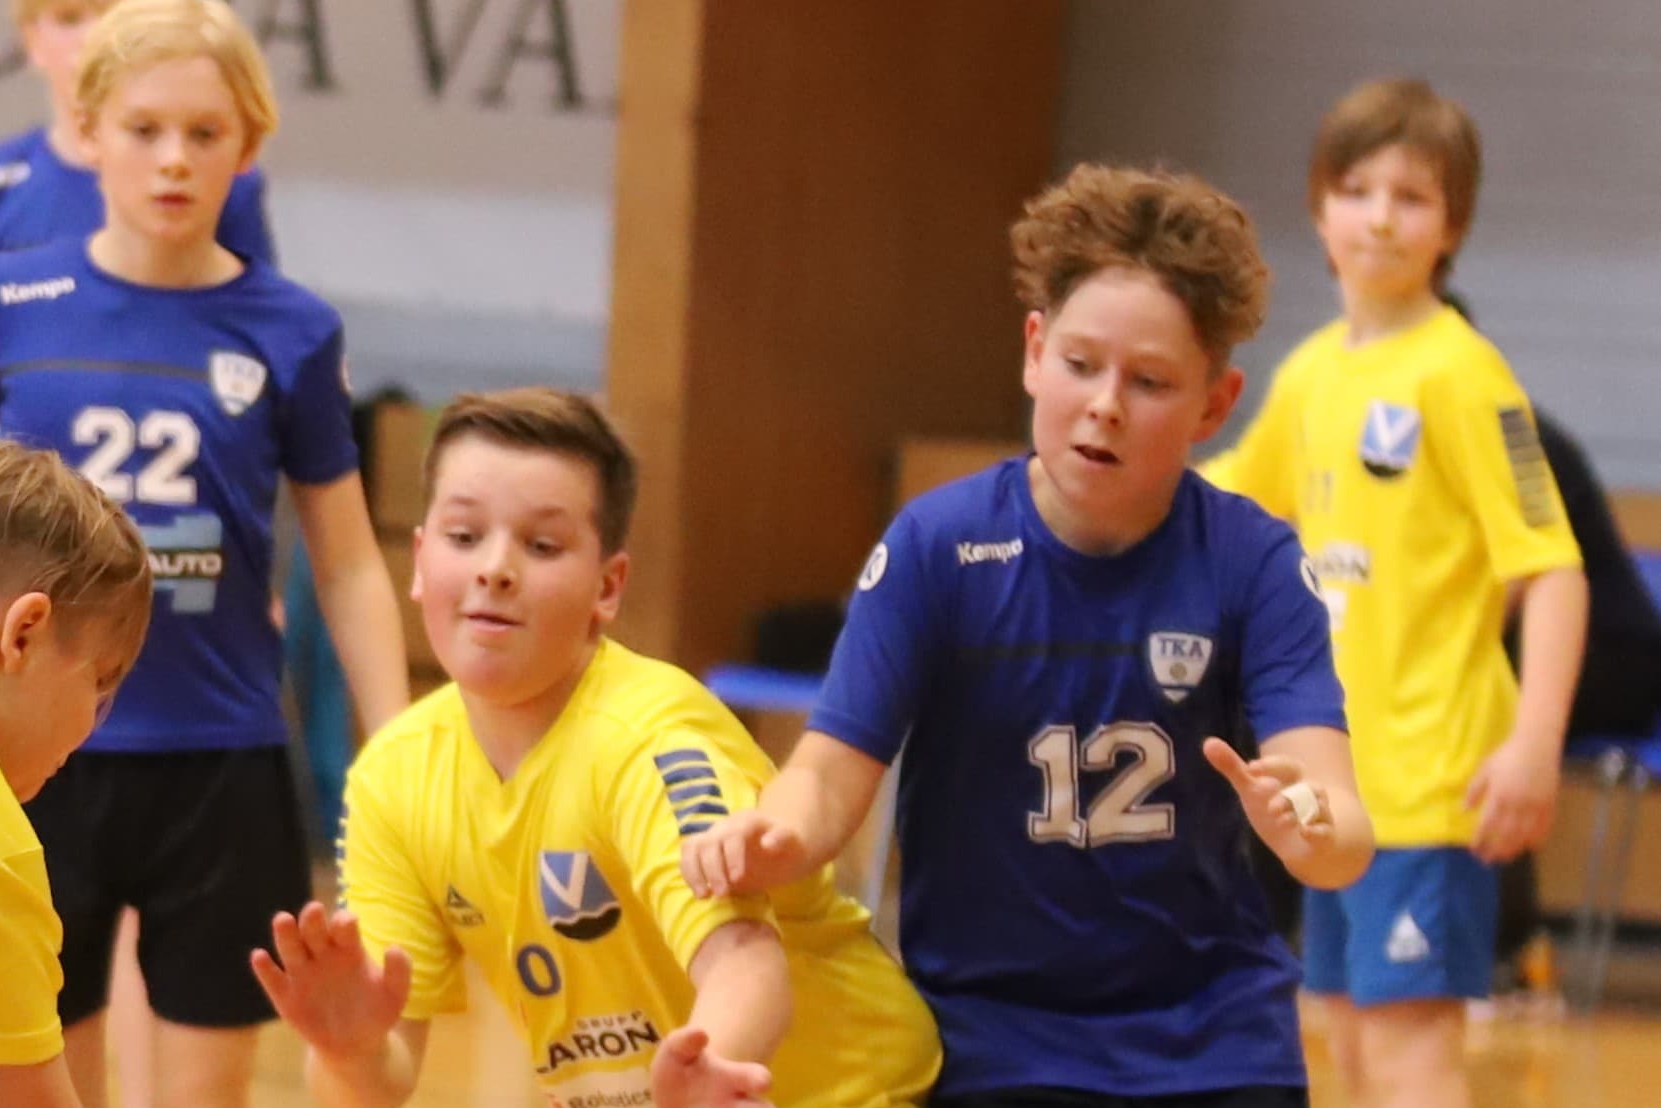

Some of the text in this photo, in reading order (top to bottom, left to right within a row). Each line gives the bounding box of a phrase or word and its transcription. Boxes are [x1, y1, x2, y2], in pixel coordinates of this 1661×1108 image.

[72, 405, 201, 504] 22
[957, 538, 1024, 565] Kempa
[1157, 637, 1205, 658] TKA
[1028, 721, 1175, 849] 12
[516, 944, 561, 997] 0
